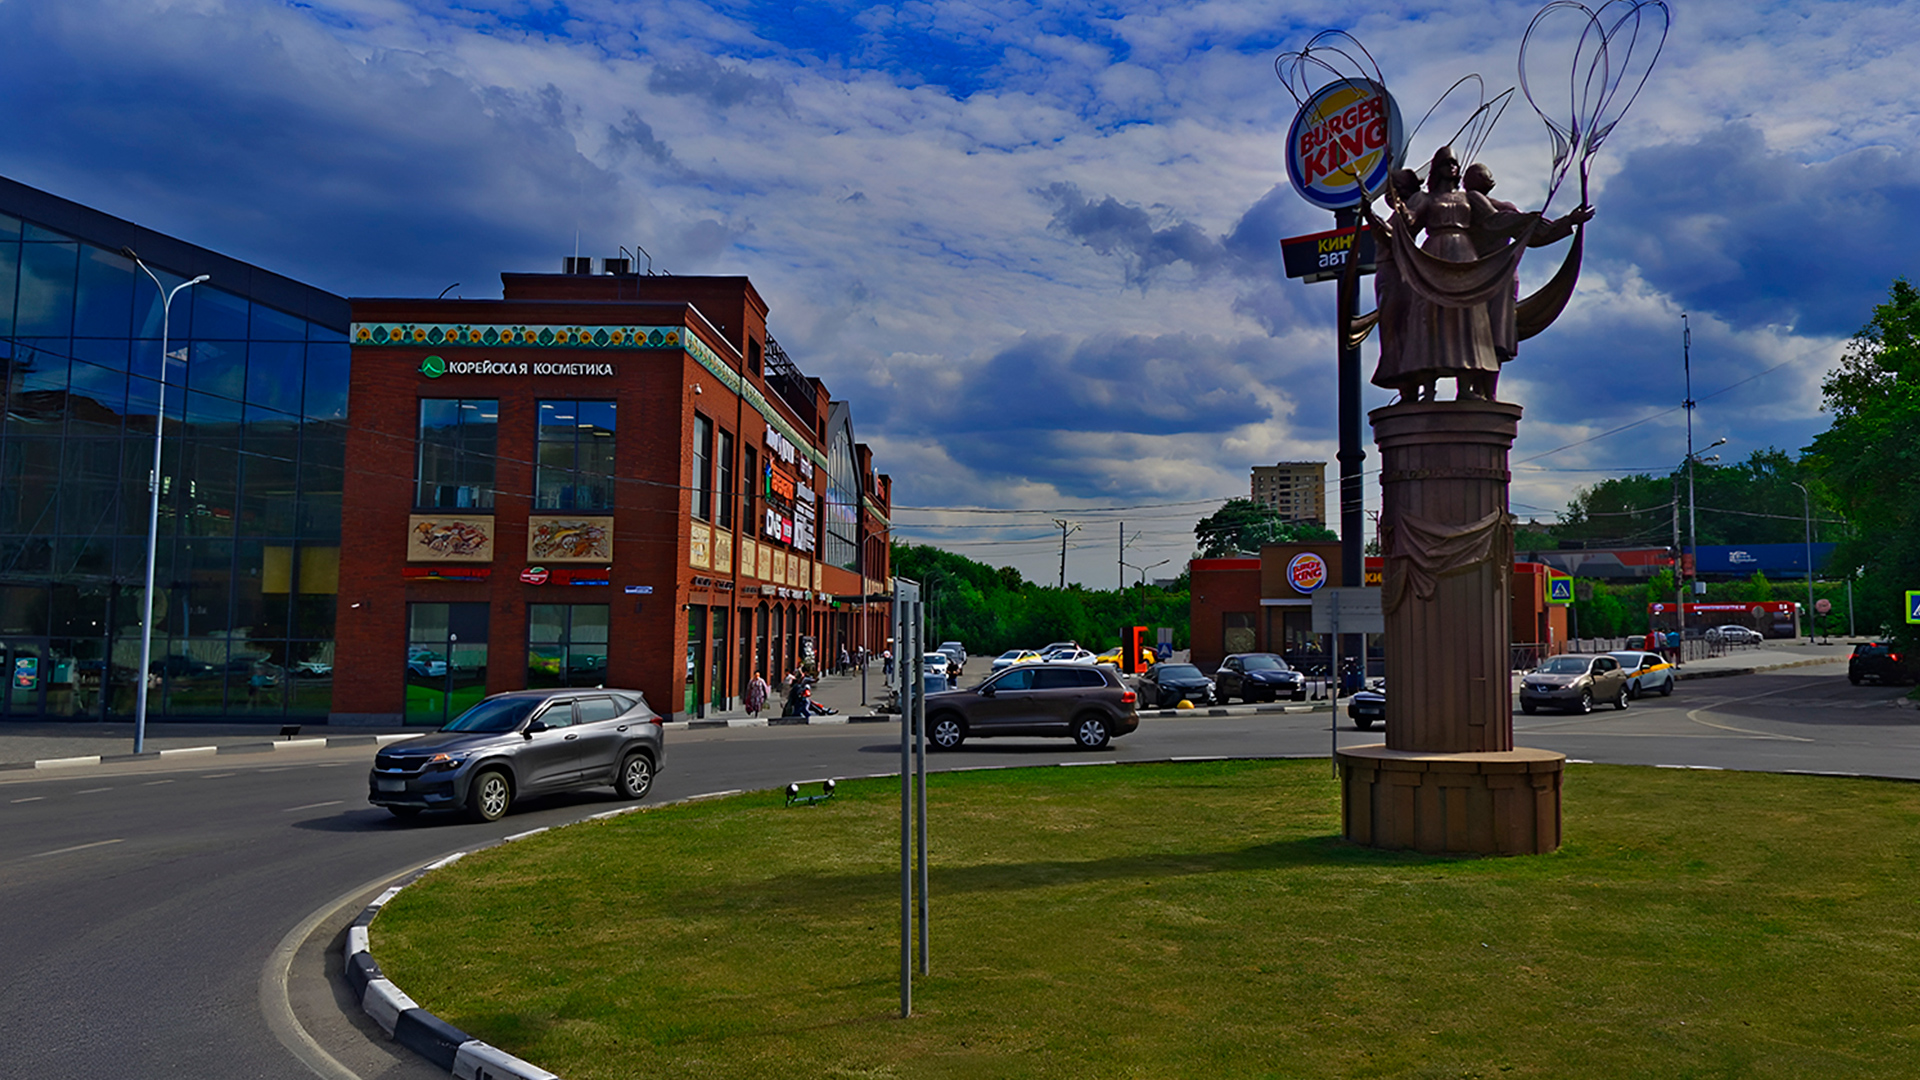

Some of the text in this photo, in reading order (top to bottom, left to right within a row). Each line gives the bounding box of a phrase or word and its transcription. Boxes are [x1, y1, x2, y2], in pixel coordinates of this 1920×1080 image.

[1301, 96, 1384, 157] BURGER
[1304, 117, 1387, 188] KING
[1318, 233, 1356, 253] КИН
[1318, 251, 1361, 268] авт
[449, 360, 613, 376] КОРЕЙСКАЯ КОСМЕТИКА
